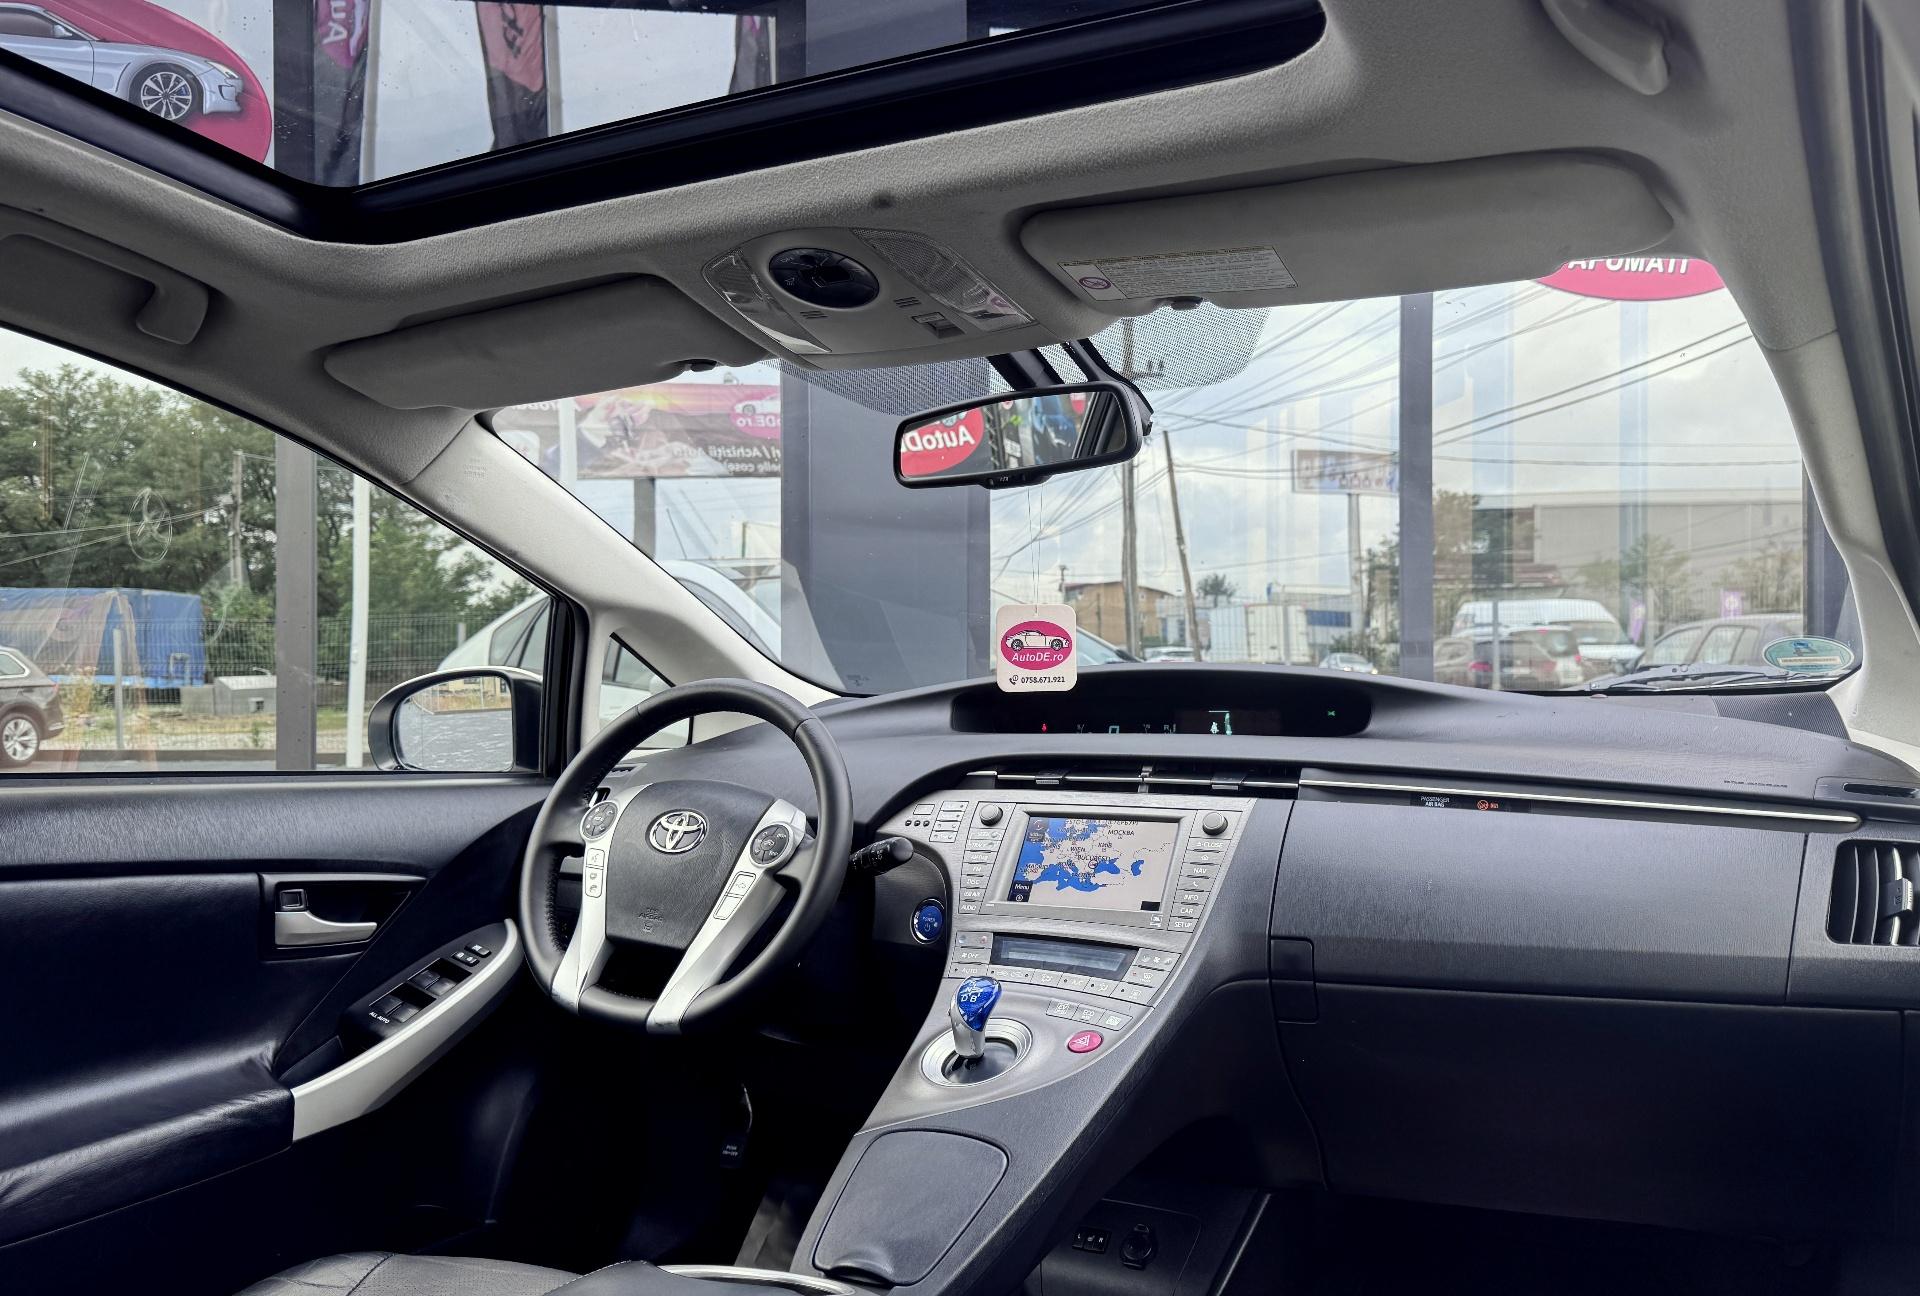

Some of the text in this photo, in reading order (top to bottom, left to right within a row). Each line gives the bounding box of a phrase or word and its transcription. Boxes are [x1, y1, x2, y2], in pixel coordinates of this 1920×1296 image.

[1011, 652, 1064, 662] AutoDE.ro
[1083, 1009, 1095, 1017] ECO
[377, 1015, 390, 1024] AUTO
